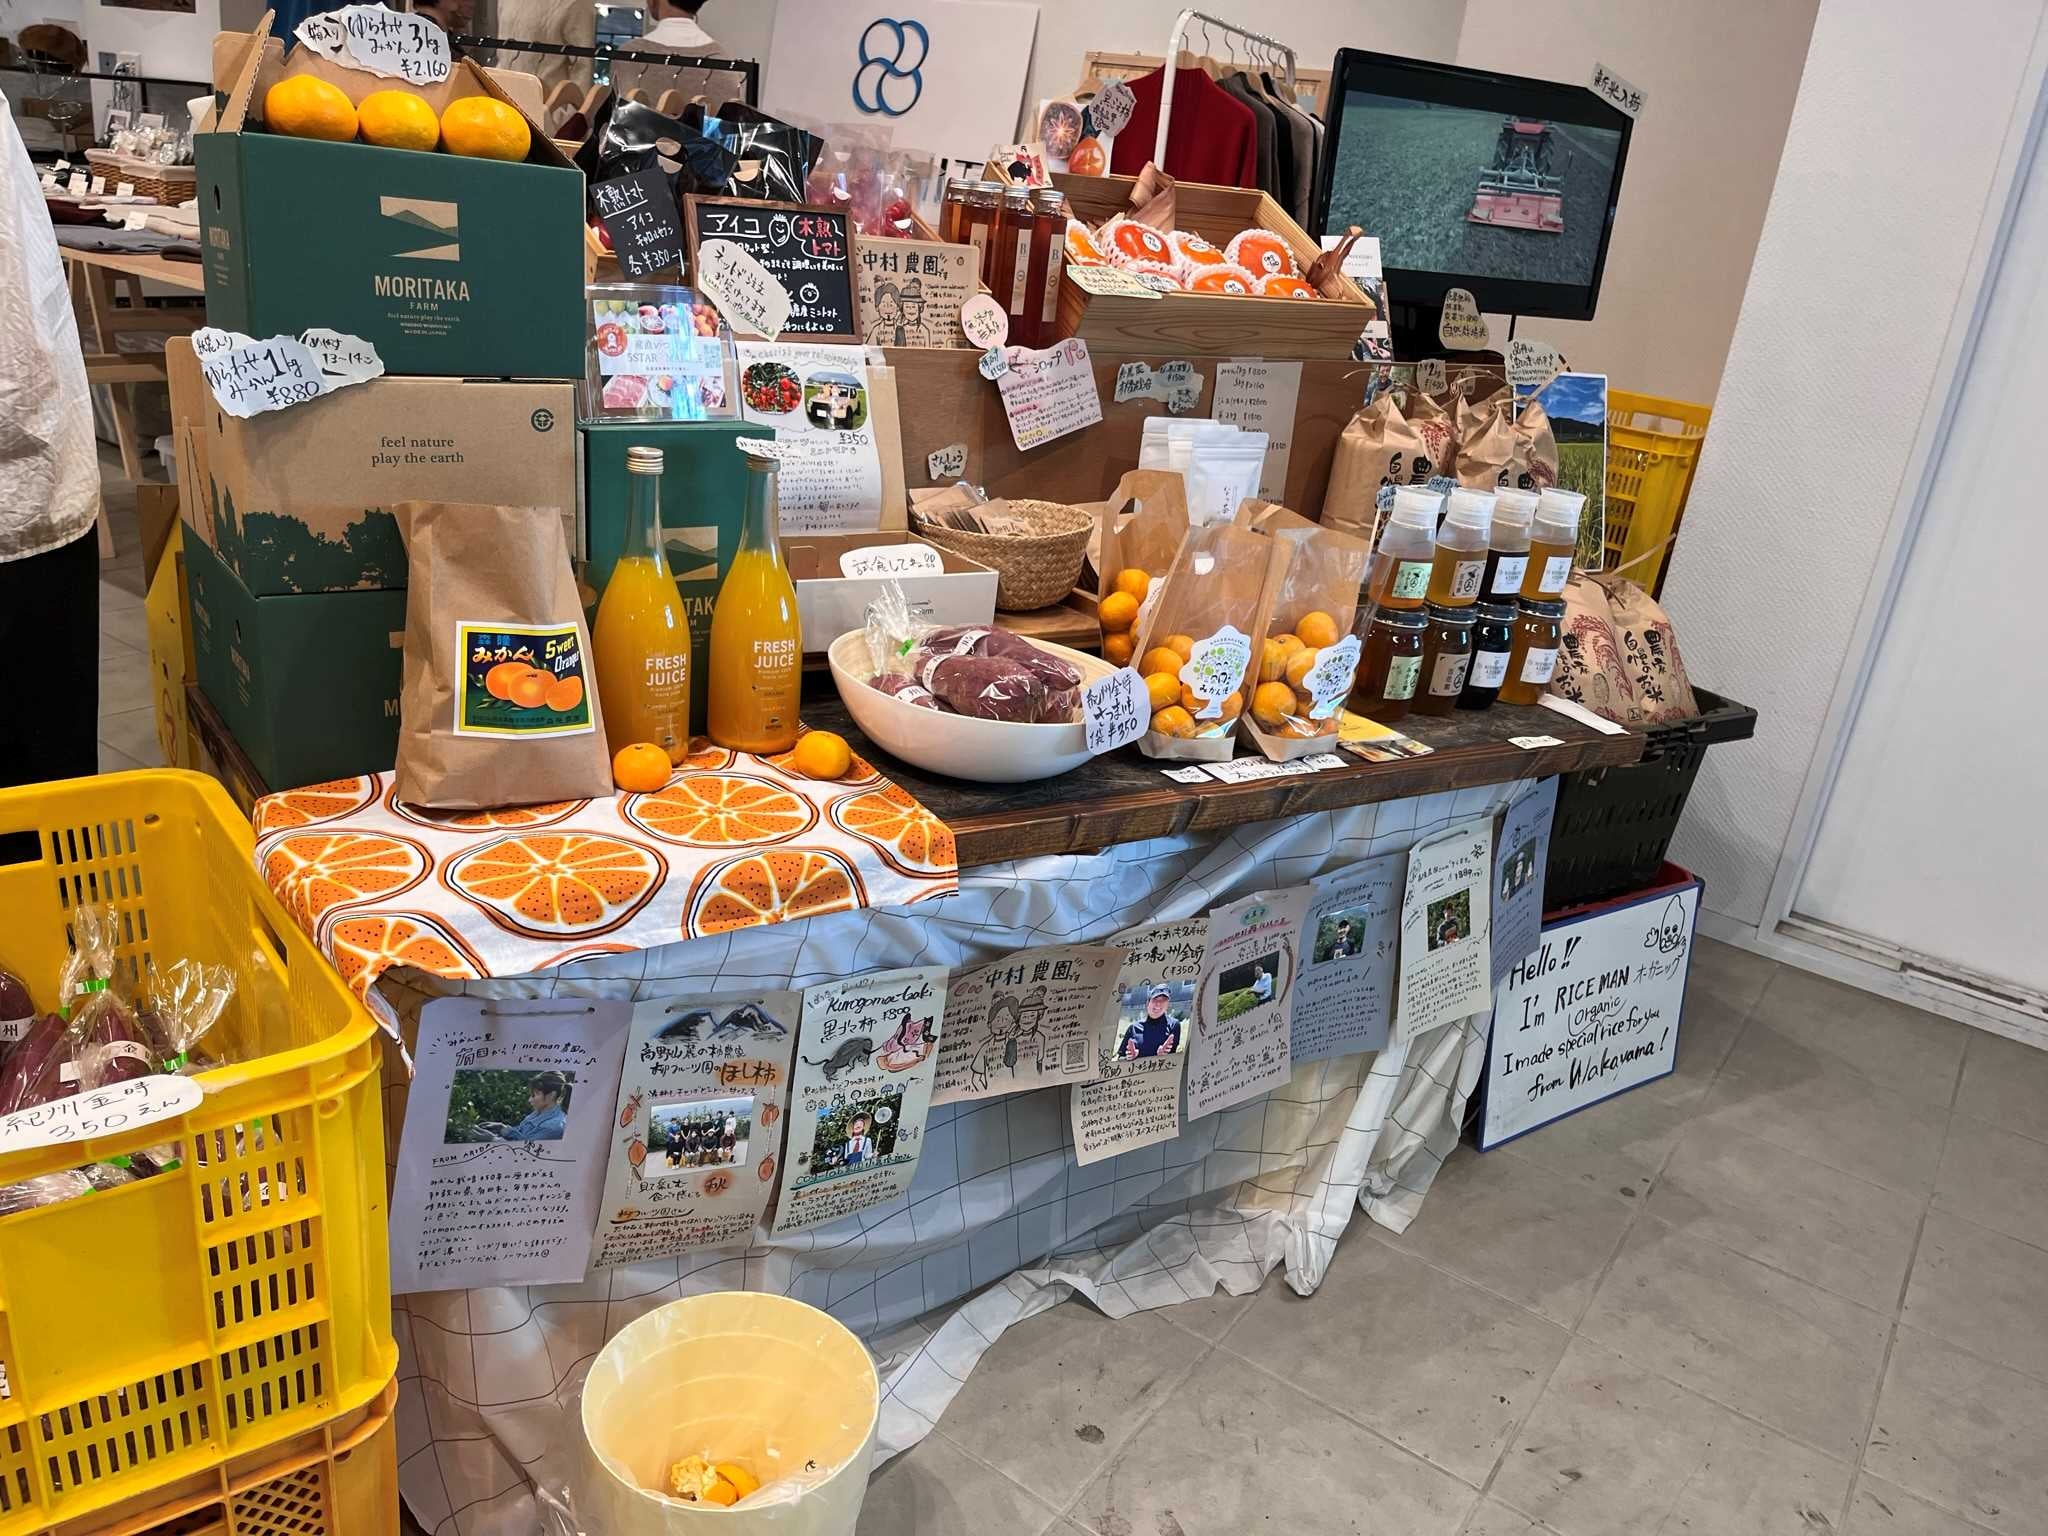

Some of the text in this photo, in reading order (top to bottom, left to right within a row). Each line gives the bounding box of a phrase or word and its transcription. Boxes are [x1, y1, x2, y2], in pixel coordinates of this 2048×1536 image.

[705, 213, 762, 234] アイコ
[798, 216, 833, 238] 木熟
[812, 238, 841, 257] トマト
[374, 275, 471, 302] MORITAKA
[409, 301, 440, 312] FARM
[266, 380, 320, 406] ¥880
[380, 435, 455, 449] feel nature
[371, 451, 465, 468] play the earth
[472, 645, 535, 664] みかん
[753, 639, 796, 654] FRESH
[645, 653, 687, 671] FRESH
[753, 653, 795, 669] JUICE
[645, 669, 686, 687] JUICE
[1519, 994, 1545, 1033] I'm
[1557, 1022, 1599, 1059] special
[1599, 1020, 1625, 1041] rice
[1625, 1005, 1643, 1038] for
[1636, 1007, 1660, 1035] you
[1527, 1072, 1565, 1102] from
[432, 1155, 457, 1165] FROM
